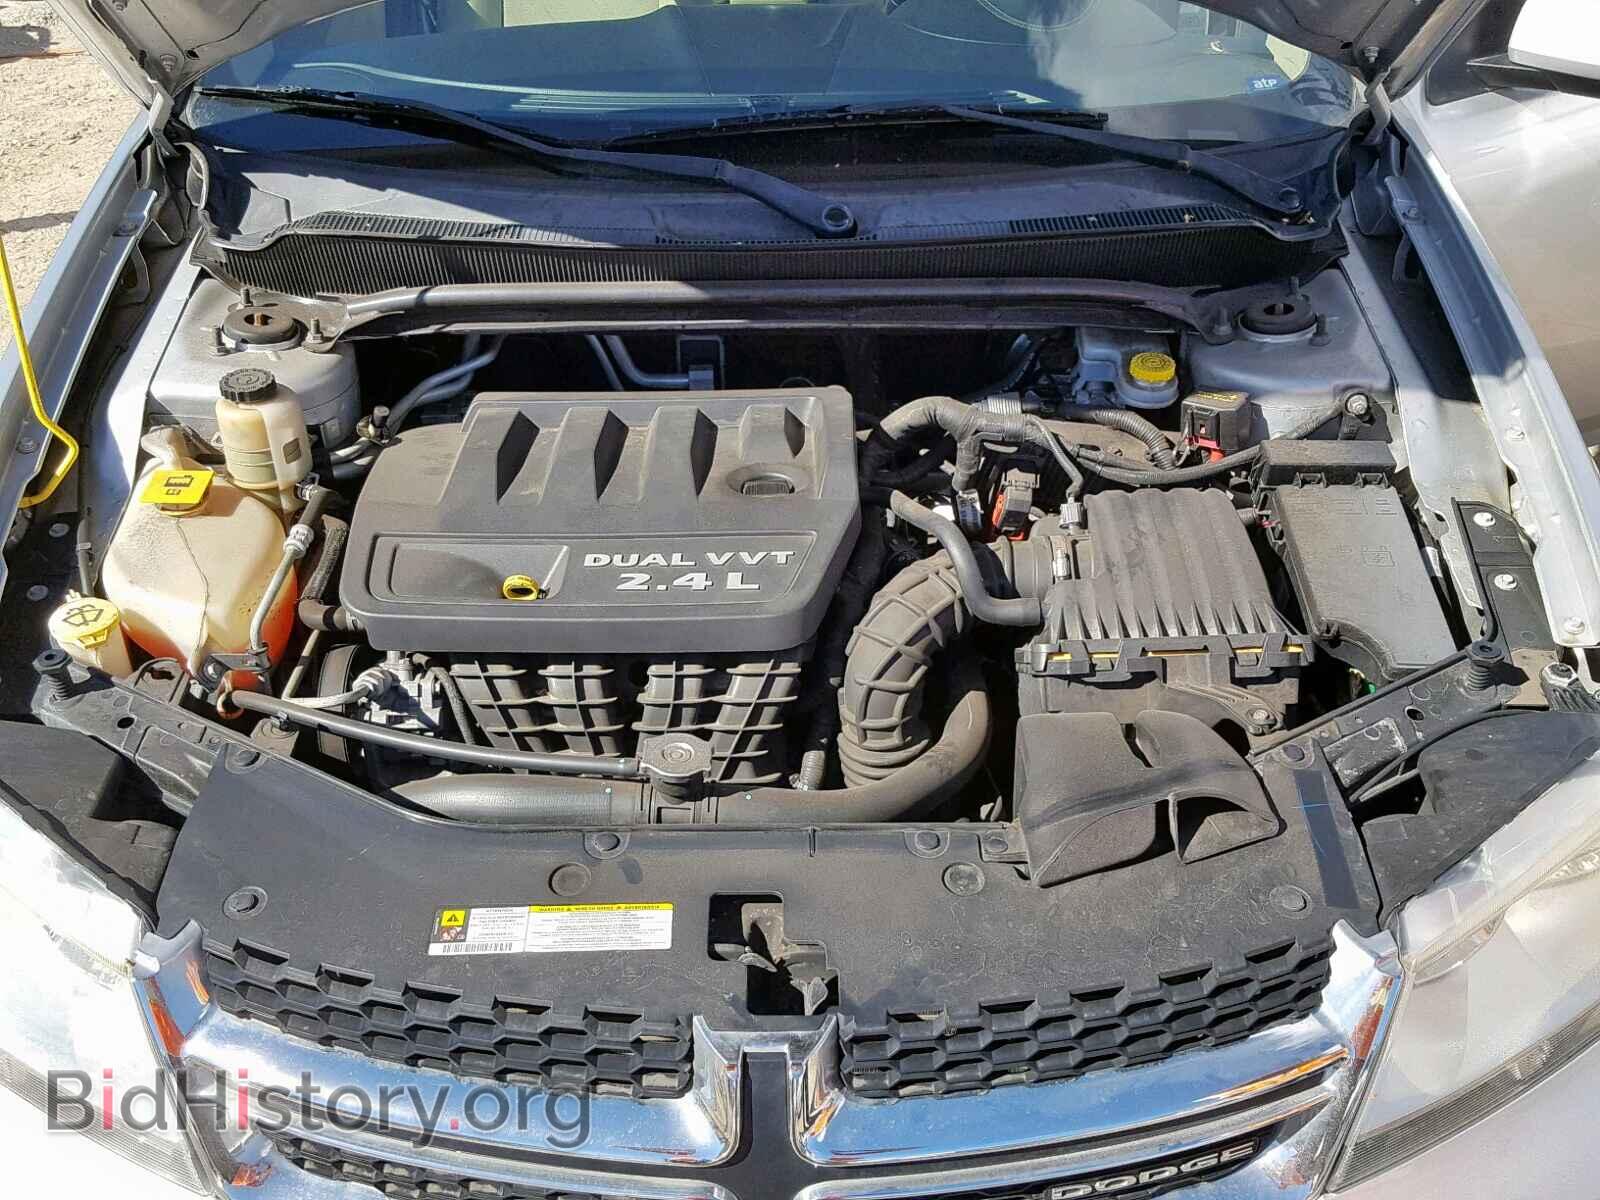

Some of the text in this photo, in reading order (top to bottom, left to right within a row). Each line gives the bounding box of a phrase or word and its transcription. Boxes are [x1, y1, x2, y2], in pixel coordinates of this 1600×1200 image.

[583, 551, 795, 567] DUAL VVT
[1051, 1140, 1255, 1200] DODGE
